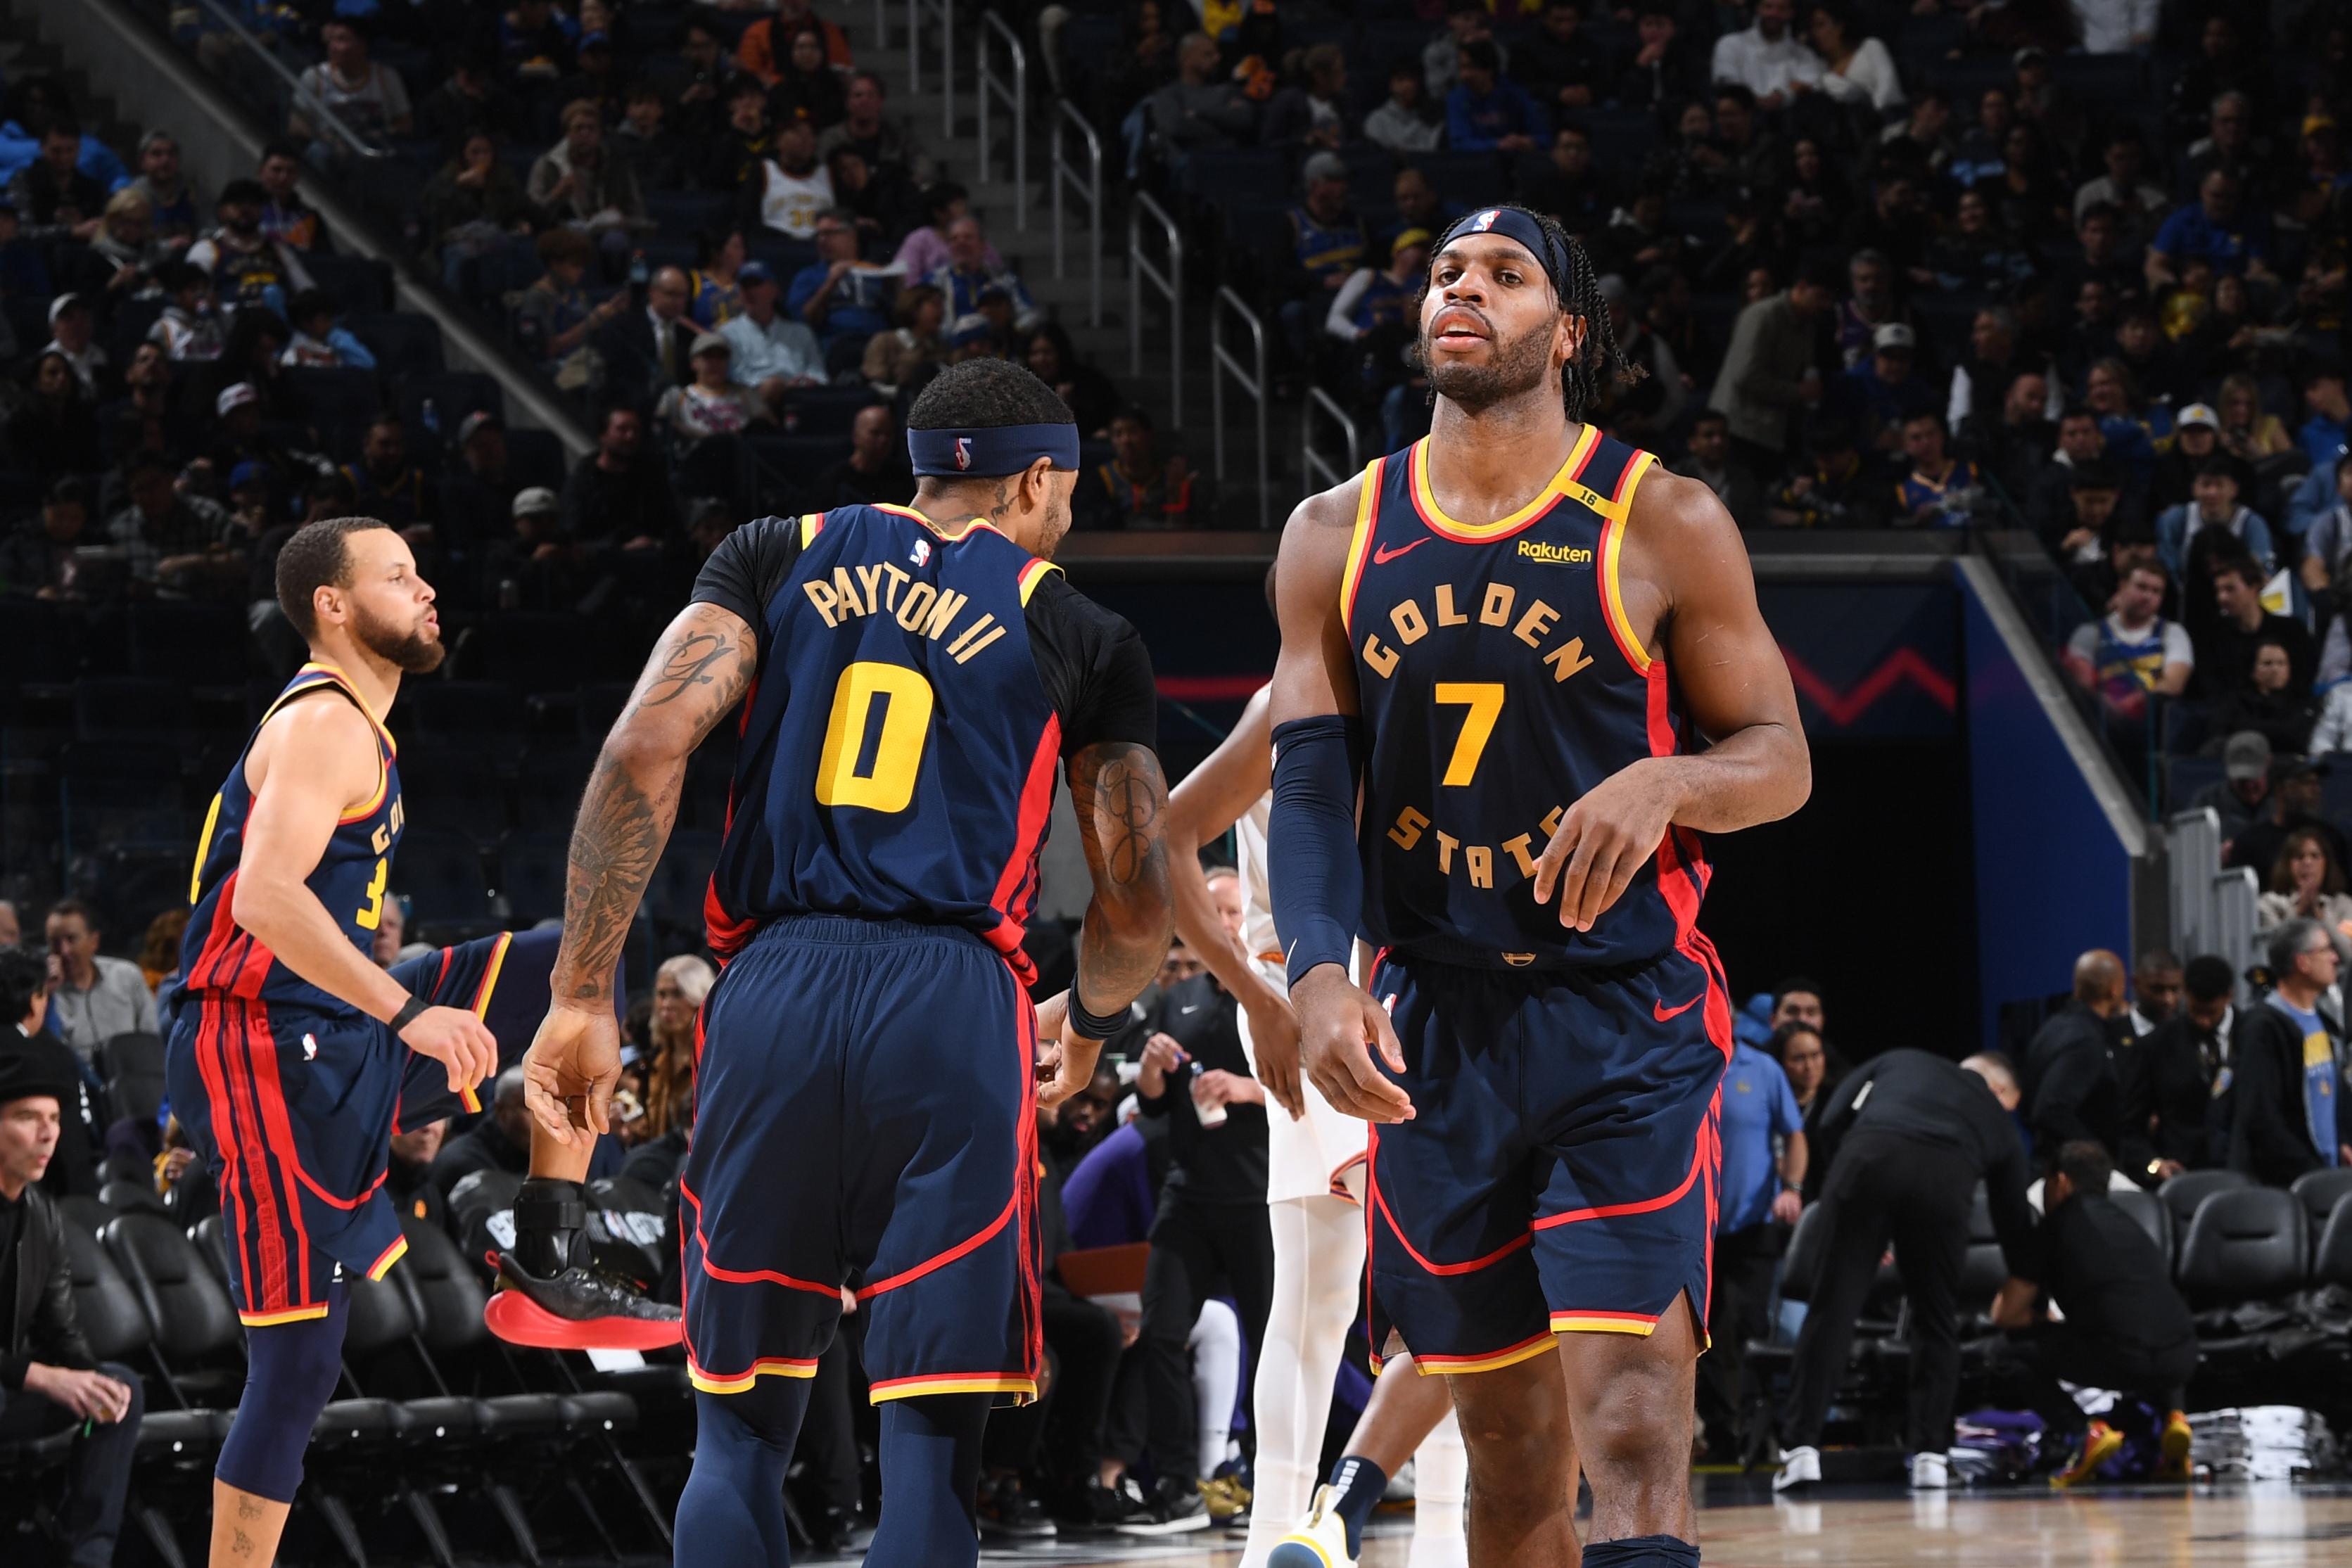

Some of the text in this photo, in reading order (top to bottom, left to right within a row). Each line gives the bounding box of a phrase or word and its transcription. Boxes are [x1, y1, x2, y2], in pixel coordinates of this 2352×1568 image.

[1579, 490, 1598, 506] 16
[1518, 540, 1591, 563] Rakuten
[802, 561, 969, 641] PAYTON
[1362, 582, 1594, 684] GOLDEN
[815, 661, 934, 813] 0
[1435, 682, 1506, 786] 7
